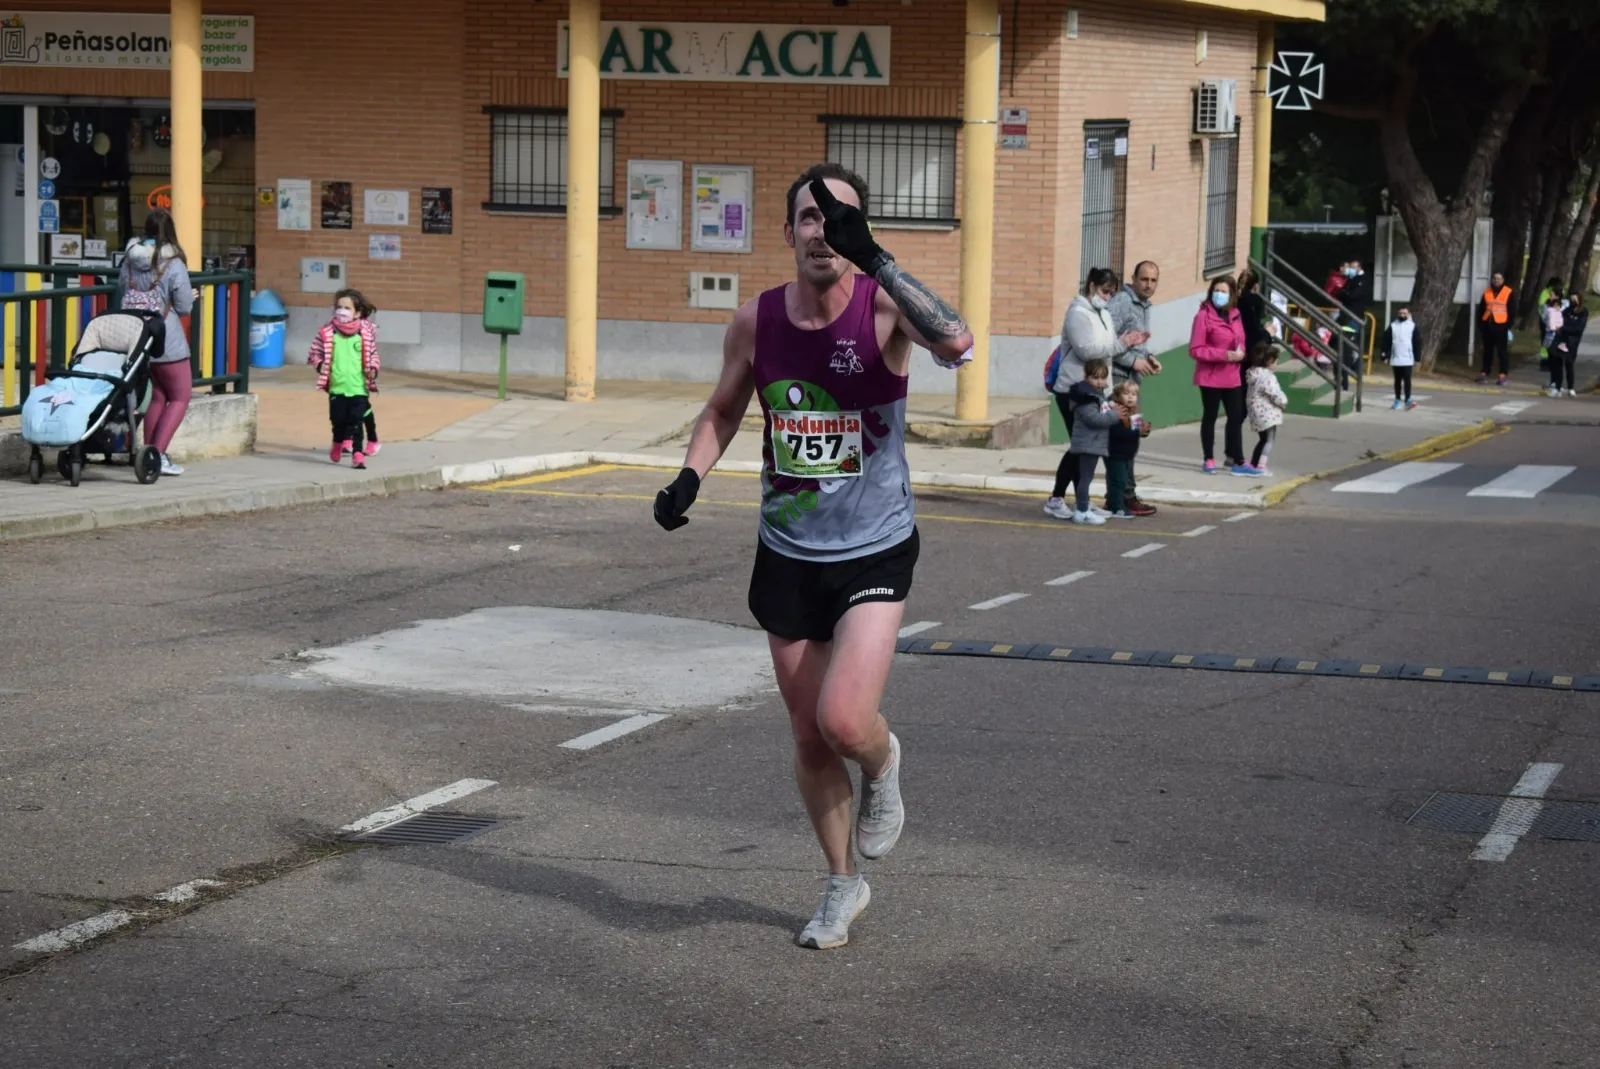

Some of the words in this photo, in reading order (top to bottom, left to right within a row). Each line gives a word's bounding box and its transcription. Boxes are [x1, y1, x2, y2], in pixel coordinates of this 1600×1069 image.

[45, 31, 171, 52] Peñasolan
[205, 30, 236, 39] bazar
[118, 55, 171, 65] mark
[774, 415, 859, 434] bedunia
[787, 434, 843, 461] 757
[849, 587, 894, 603] noname
